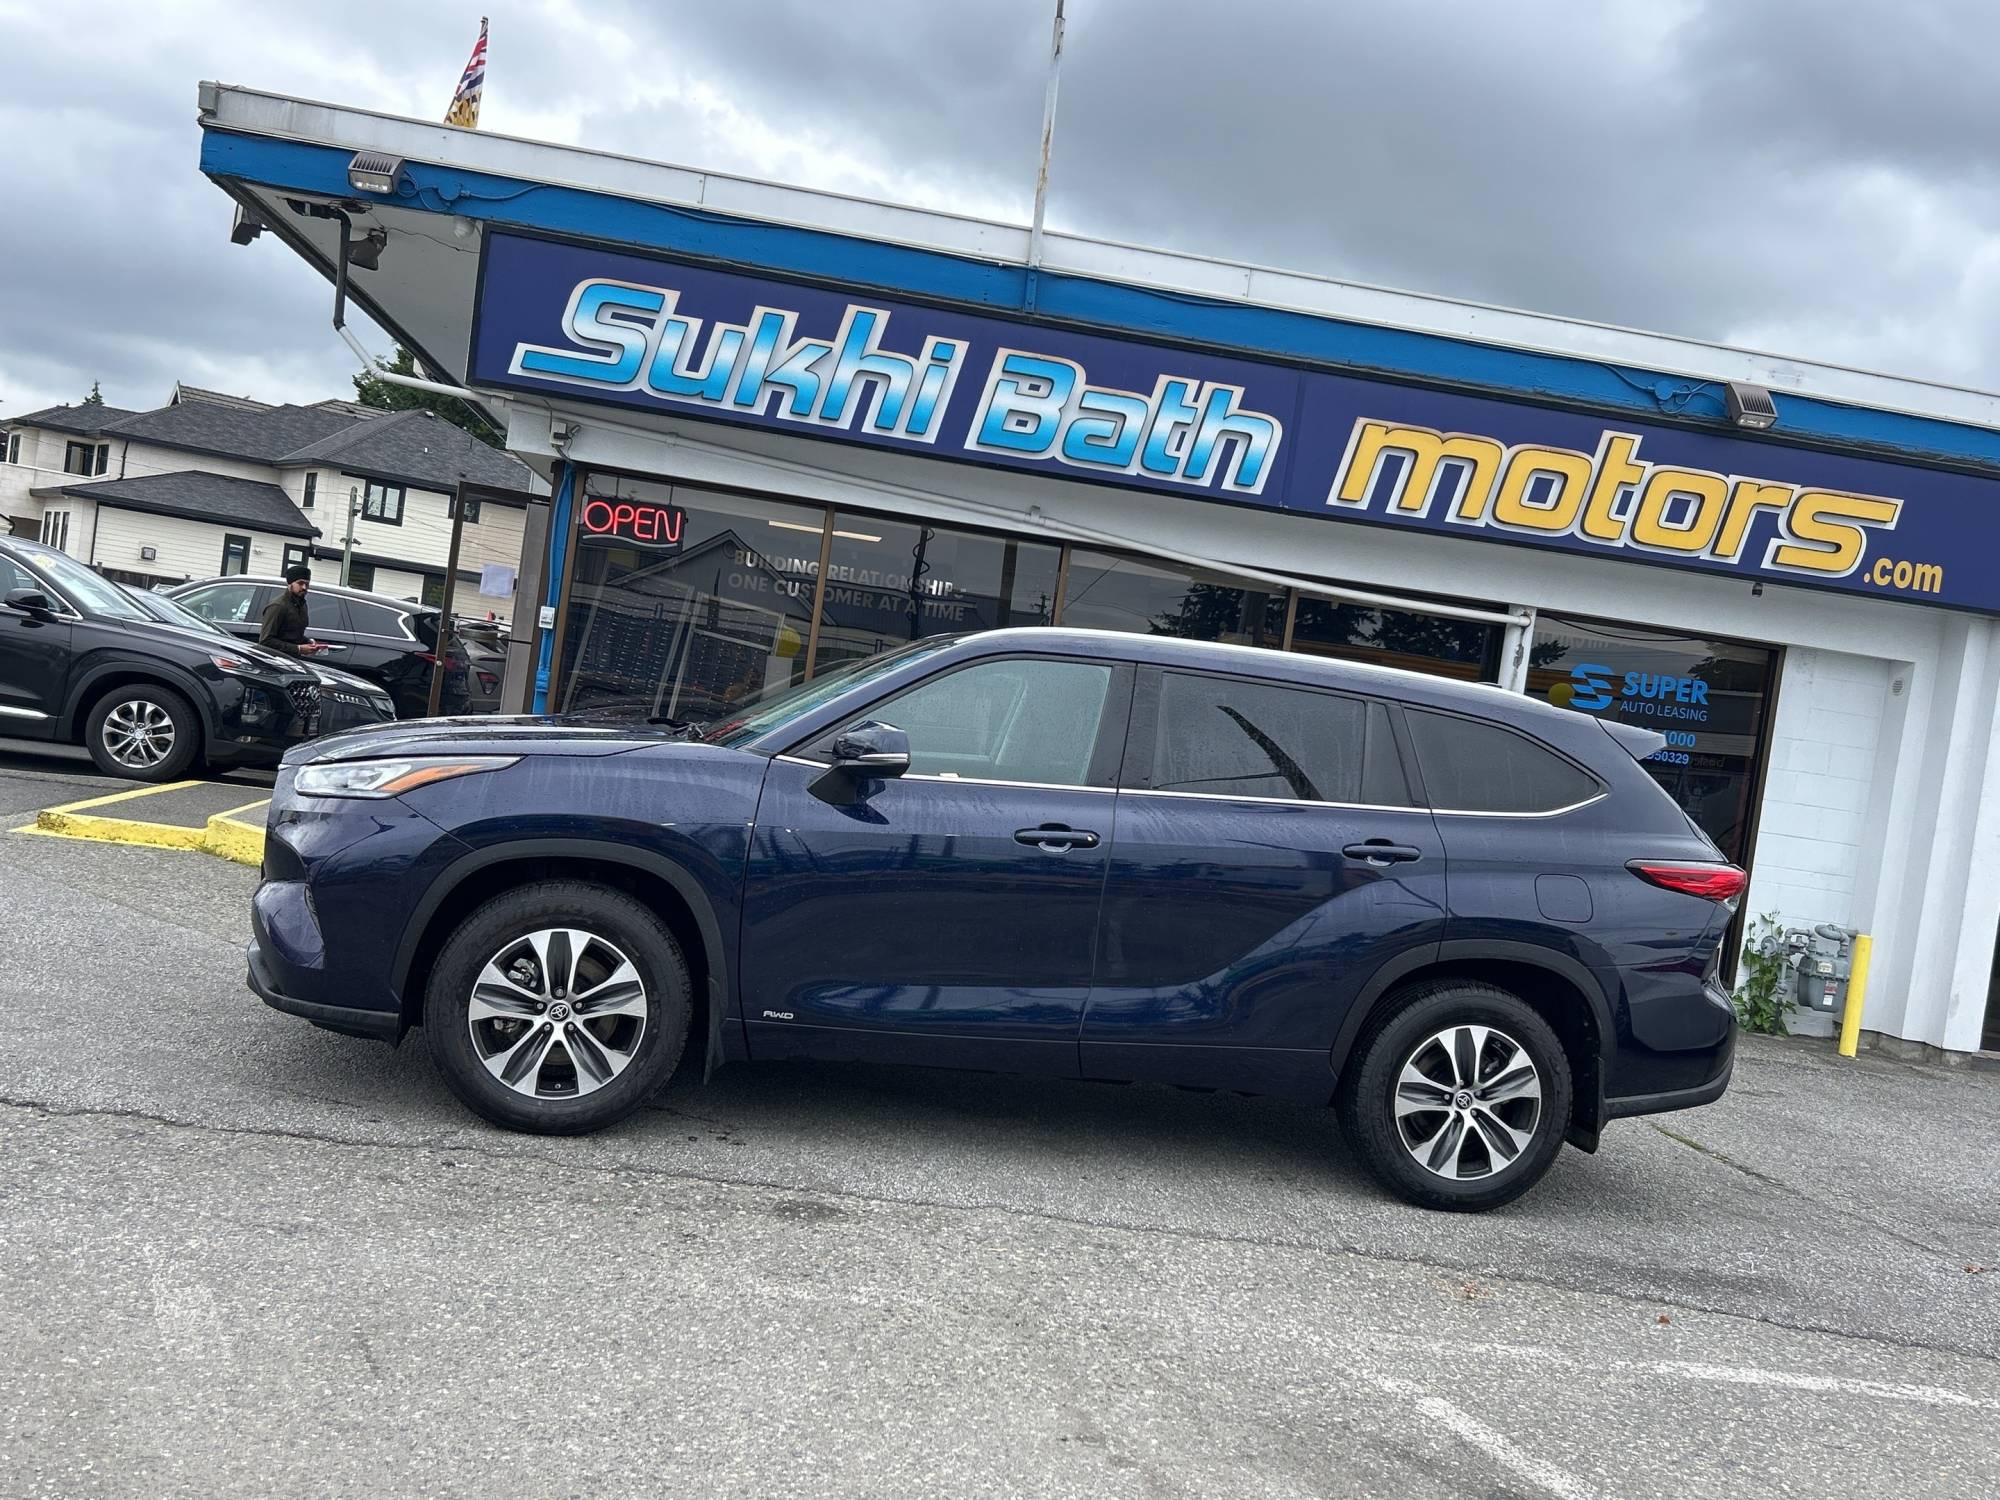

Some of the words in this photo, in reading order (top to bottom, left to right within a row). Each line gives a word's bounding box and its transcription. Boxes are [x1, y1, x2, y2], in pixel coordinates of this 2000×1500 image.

[509, 278, 969, 444] Sukhi
[965, 347, 1283, 495] Bath
[1326, 417, 1904, 578] motors
[1863, 557, 1943, 593] .com
[584, 501, 681, 542] OPEN
[728, 573, 768, 592] ONE
[878, 594, 901, 612] AT
[904, 599, 918, 615] A
[921, 600, 965, 621] TIME
[1621, 671, 1709, 705] SUPER
[1620, 700, 1655, 715] AUTO
[1656, 704, 1708, 722] LEASING
[763, 1010, 794, 1020] AWD
